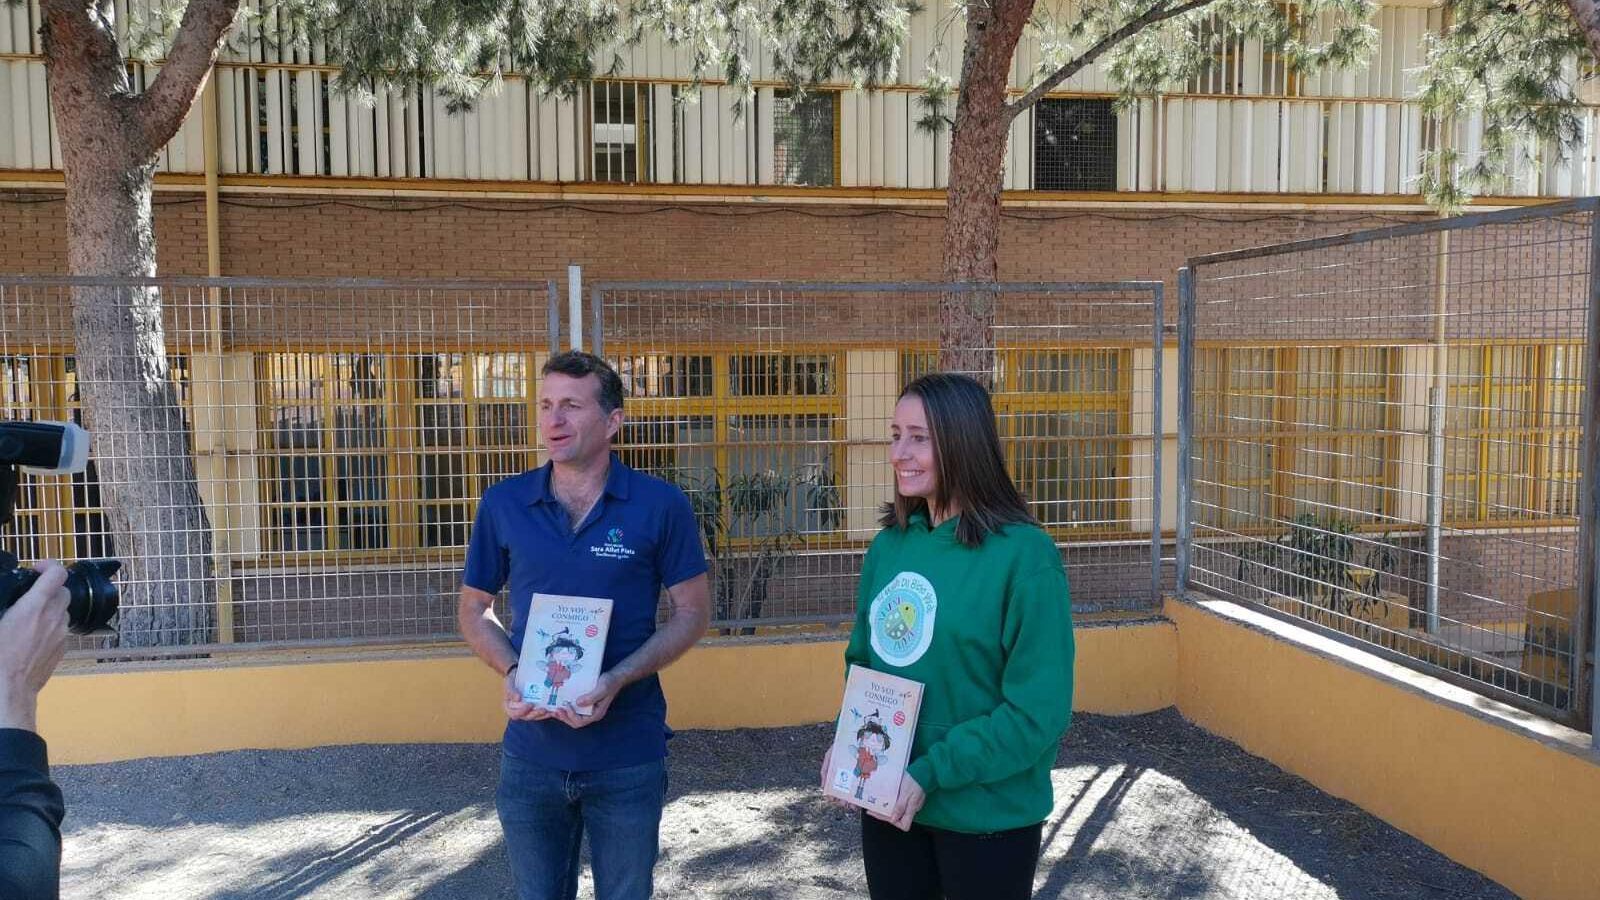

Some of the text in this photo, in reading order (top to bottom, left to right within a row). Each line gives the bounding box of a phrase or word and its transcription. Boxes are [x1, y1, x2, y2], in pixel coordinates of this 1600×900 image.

[558, 604, 586, 614] YO VOY
[551, 613, 589, 622] CONMIGO
[864, 690, 898, 705] CONMIGO
